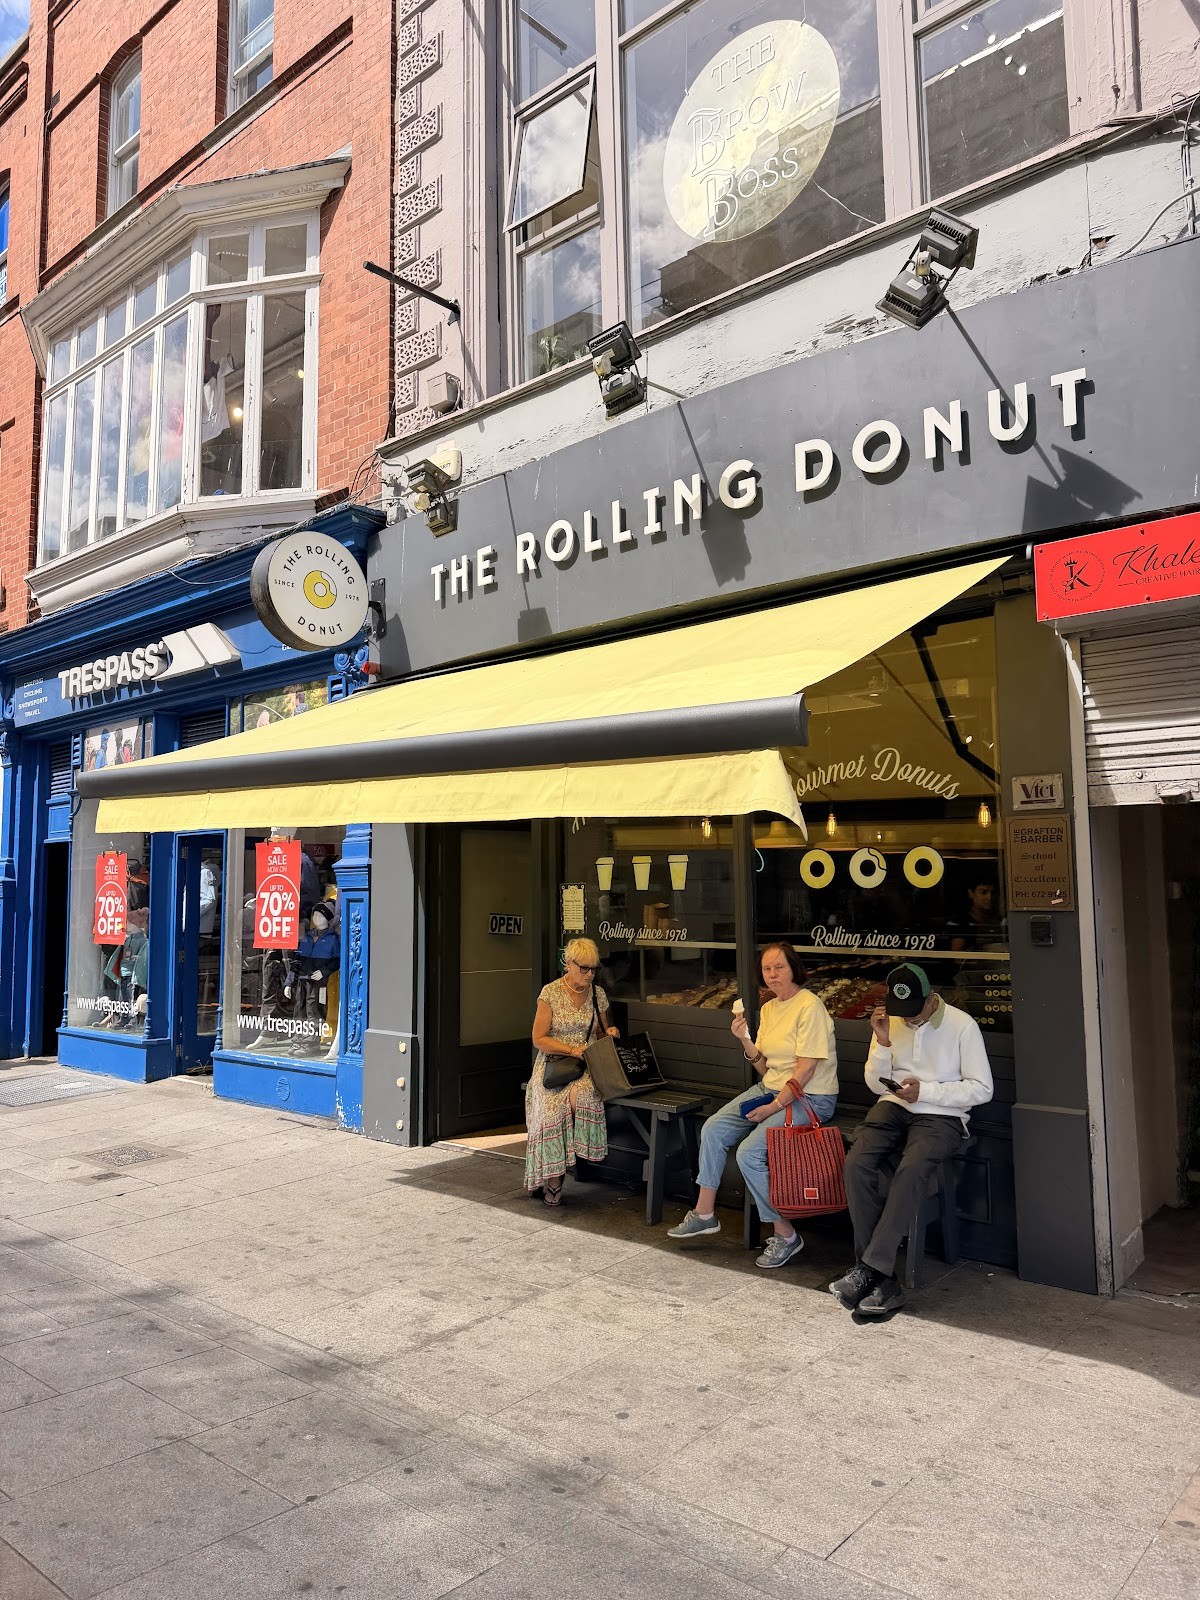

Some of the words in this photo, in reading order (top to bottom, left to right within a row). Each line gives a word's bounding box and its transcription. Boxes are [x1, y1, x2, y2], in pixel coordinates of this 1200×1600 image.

[711, 34, 775, 92] THE
[687, 70, 806, 177] BROW
[700, 147, 797, 237] BOSS
[431, 545, 495, 601] THE
[516, 459, 757, 574] ROLLING
[794, 367, 1086, 492] DONUT
[283, 550, 302, 572] THE
[306, 545, 355, 584] ROLLING
[274, 579, 295, 588] SINCE
[1136, 572, 1177, 585] CREATIVE
[345, 594, 360, 602] 1978
[297, 616, 343, 635] DONUT
[58, 643, 161, 700] TRESPASS
[24, 688, 43, 698] CYCLING
[18, 696, 48, 710] SNOWSPORTS
[25, 709, 41, 717] TRAVEL
[796, 755, 867, 797] ourmet
[871, 748, 960, 800] Donuts
[1021, 827, 1063, 835] GRAFTON
[1021, 835, 1063, 844] BARBER
[268, 854, 287, 865] SALE
[1021, 852, 1056, 860] School
[104, 865, 118, 874] SALE
[1014, 875, 1067, 883] Excellence
[98, 896, 124, 917] 70%
[260, 892, 295, 917] 70%
[490, 915, 522, 934] OPEN
[599, 921, 636, 943] Rolling
[637, 925, 663, 939] since
[665, 928, 688, 942] 1978
[811, 925, 862, 951] Rolling
[864, 930, 901, 947] since
[905, 934, 936, 950] 1978
[76, 996, 139, 1015] www.trespass.ie
[236, 1014, 331, 1037] www.trespass.ie
